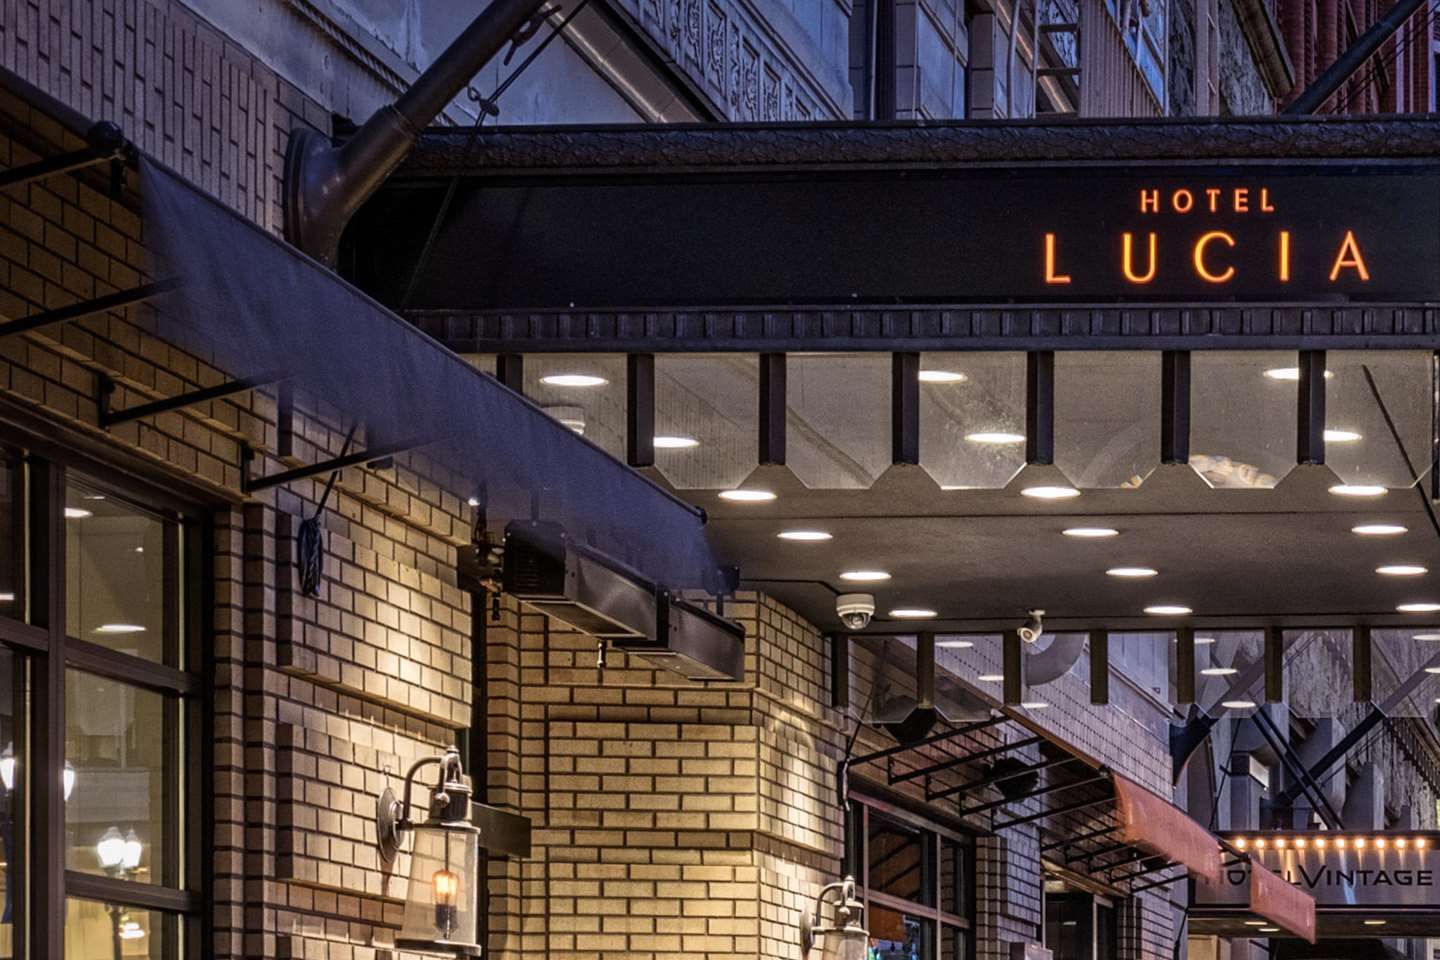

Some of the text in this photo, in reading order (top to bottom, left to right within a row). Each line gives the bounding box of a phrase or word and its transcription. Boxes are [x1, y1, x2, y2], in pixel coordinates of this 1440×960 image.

[1140, 188, 1275, 214] HOTEL
[1045, 230, 1370, 284] LUCIA
[1298, 864, 1433, 888] VINTAGE
